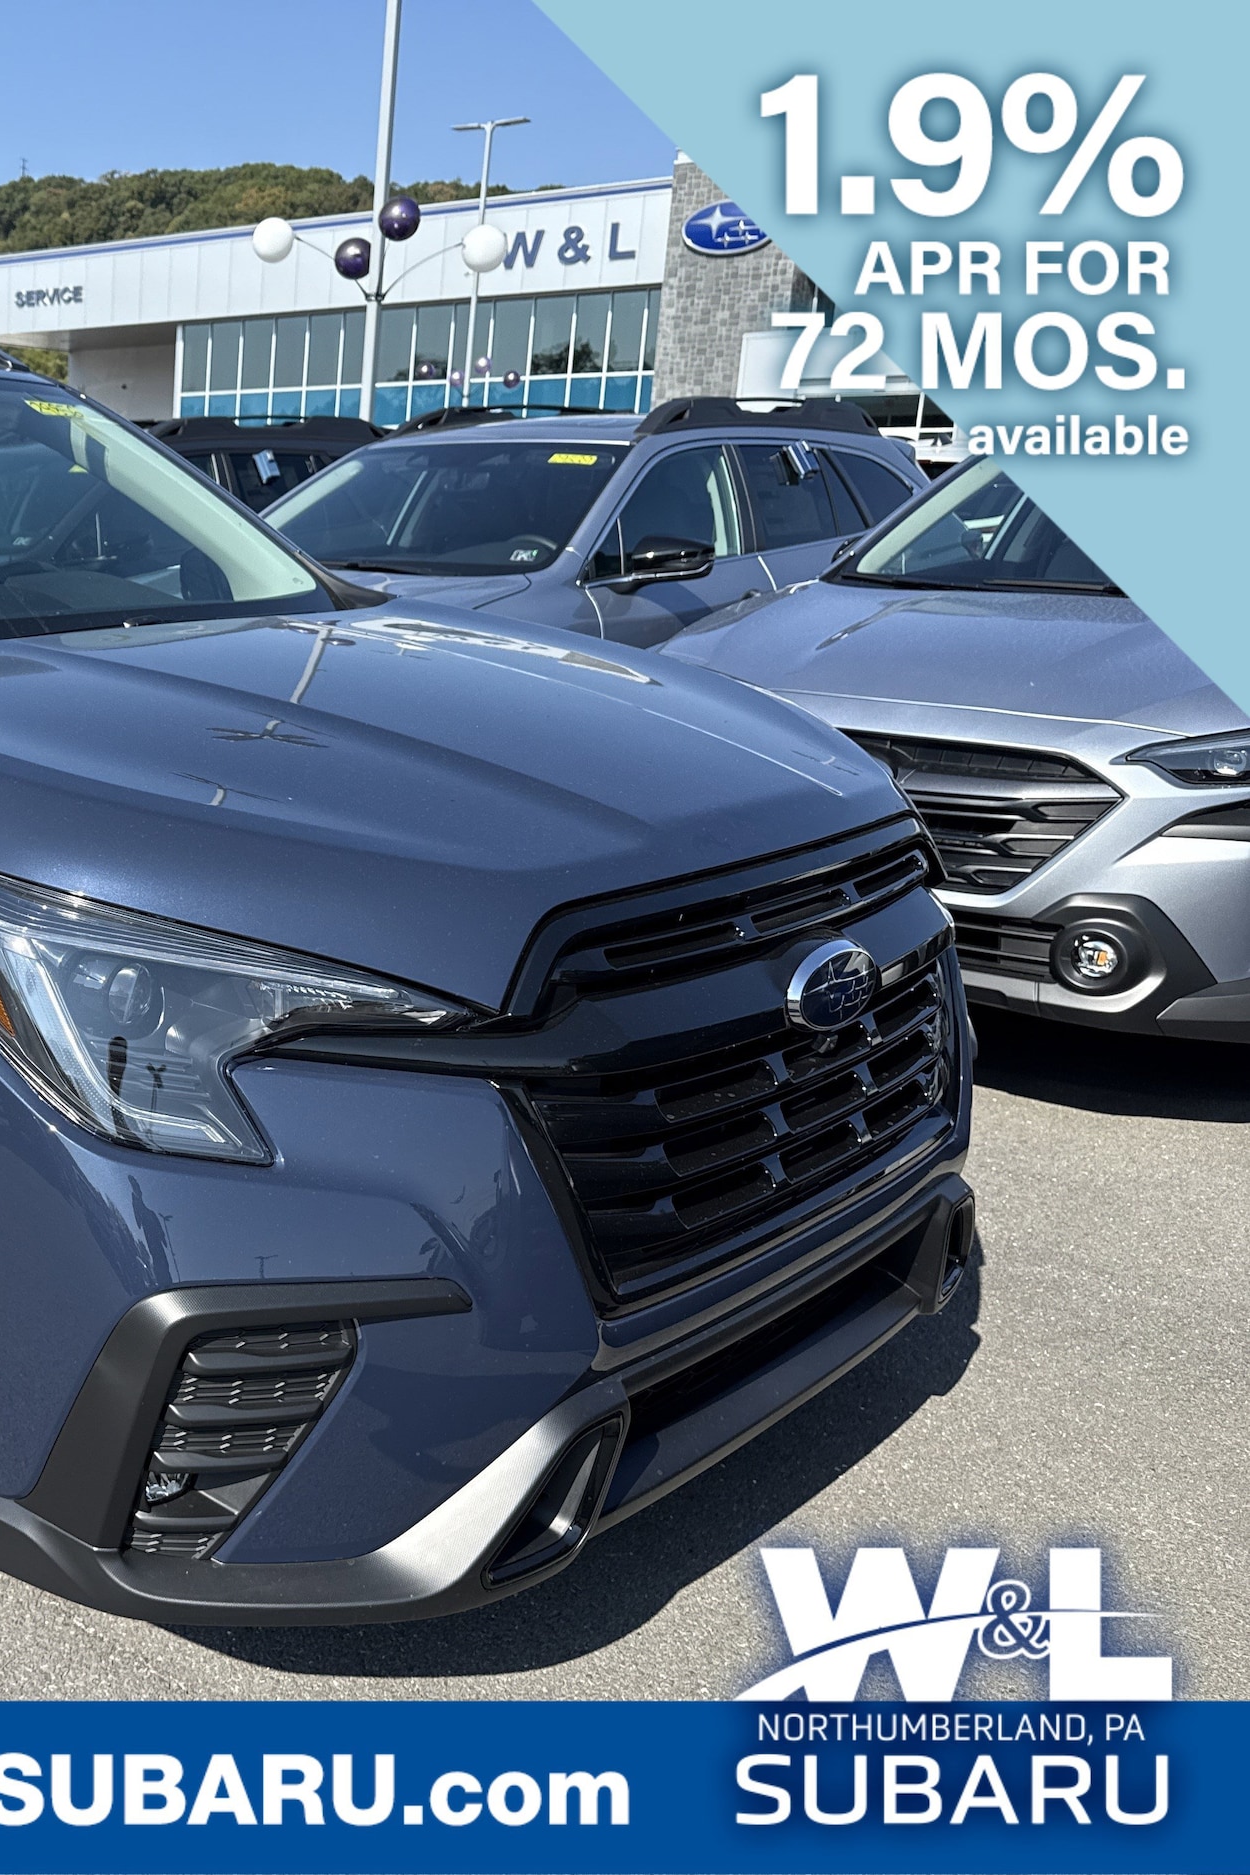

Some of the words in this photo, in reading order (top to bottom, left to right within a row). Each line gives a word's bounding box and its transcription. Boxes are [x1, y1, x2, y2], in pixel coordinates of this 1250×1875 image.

[503, 229, 545, 270] W
[557, 225, 591, 265] &
[609, 222, 636, 261] L
[14, 286, 83, 308] SERVICE
